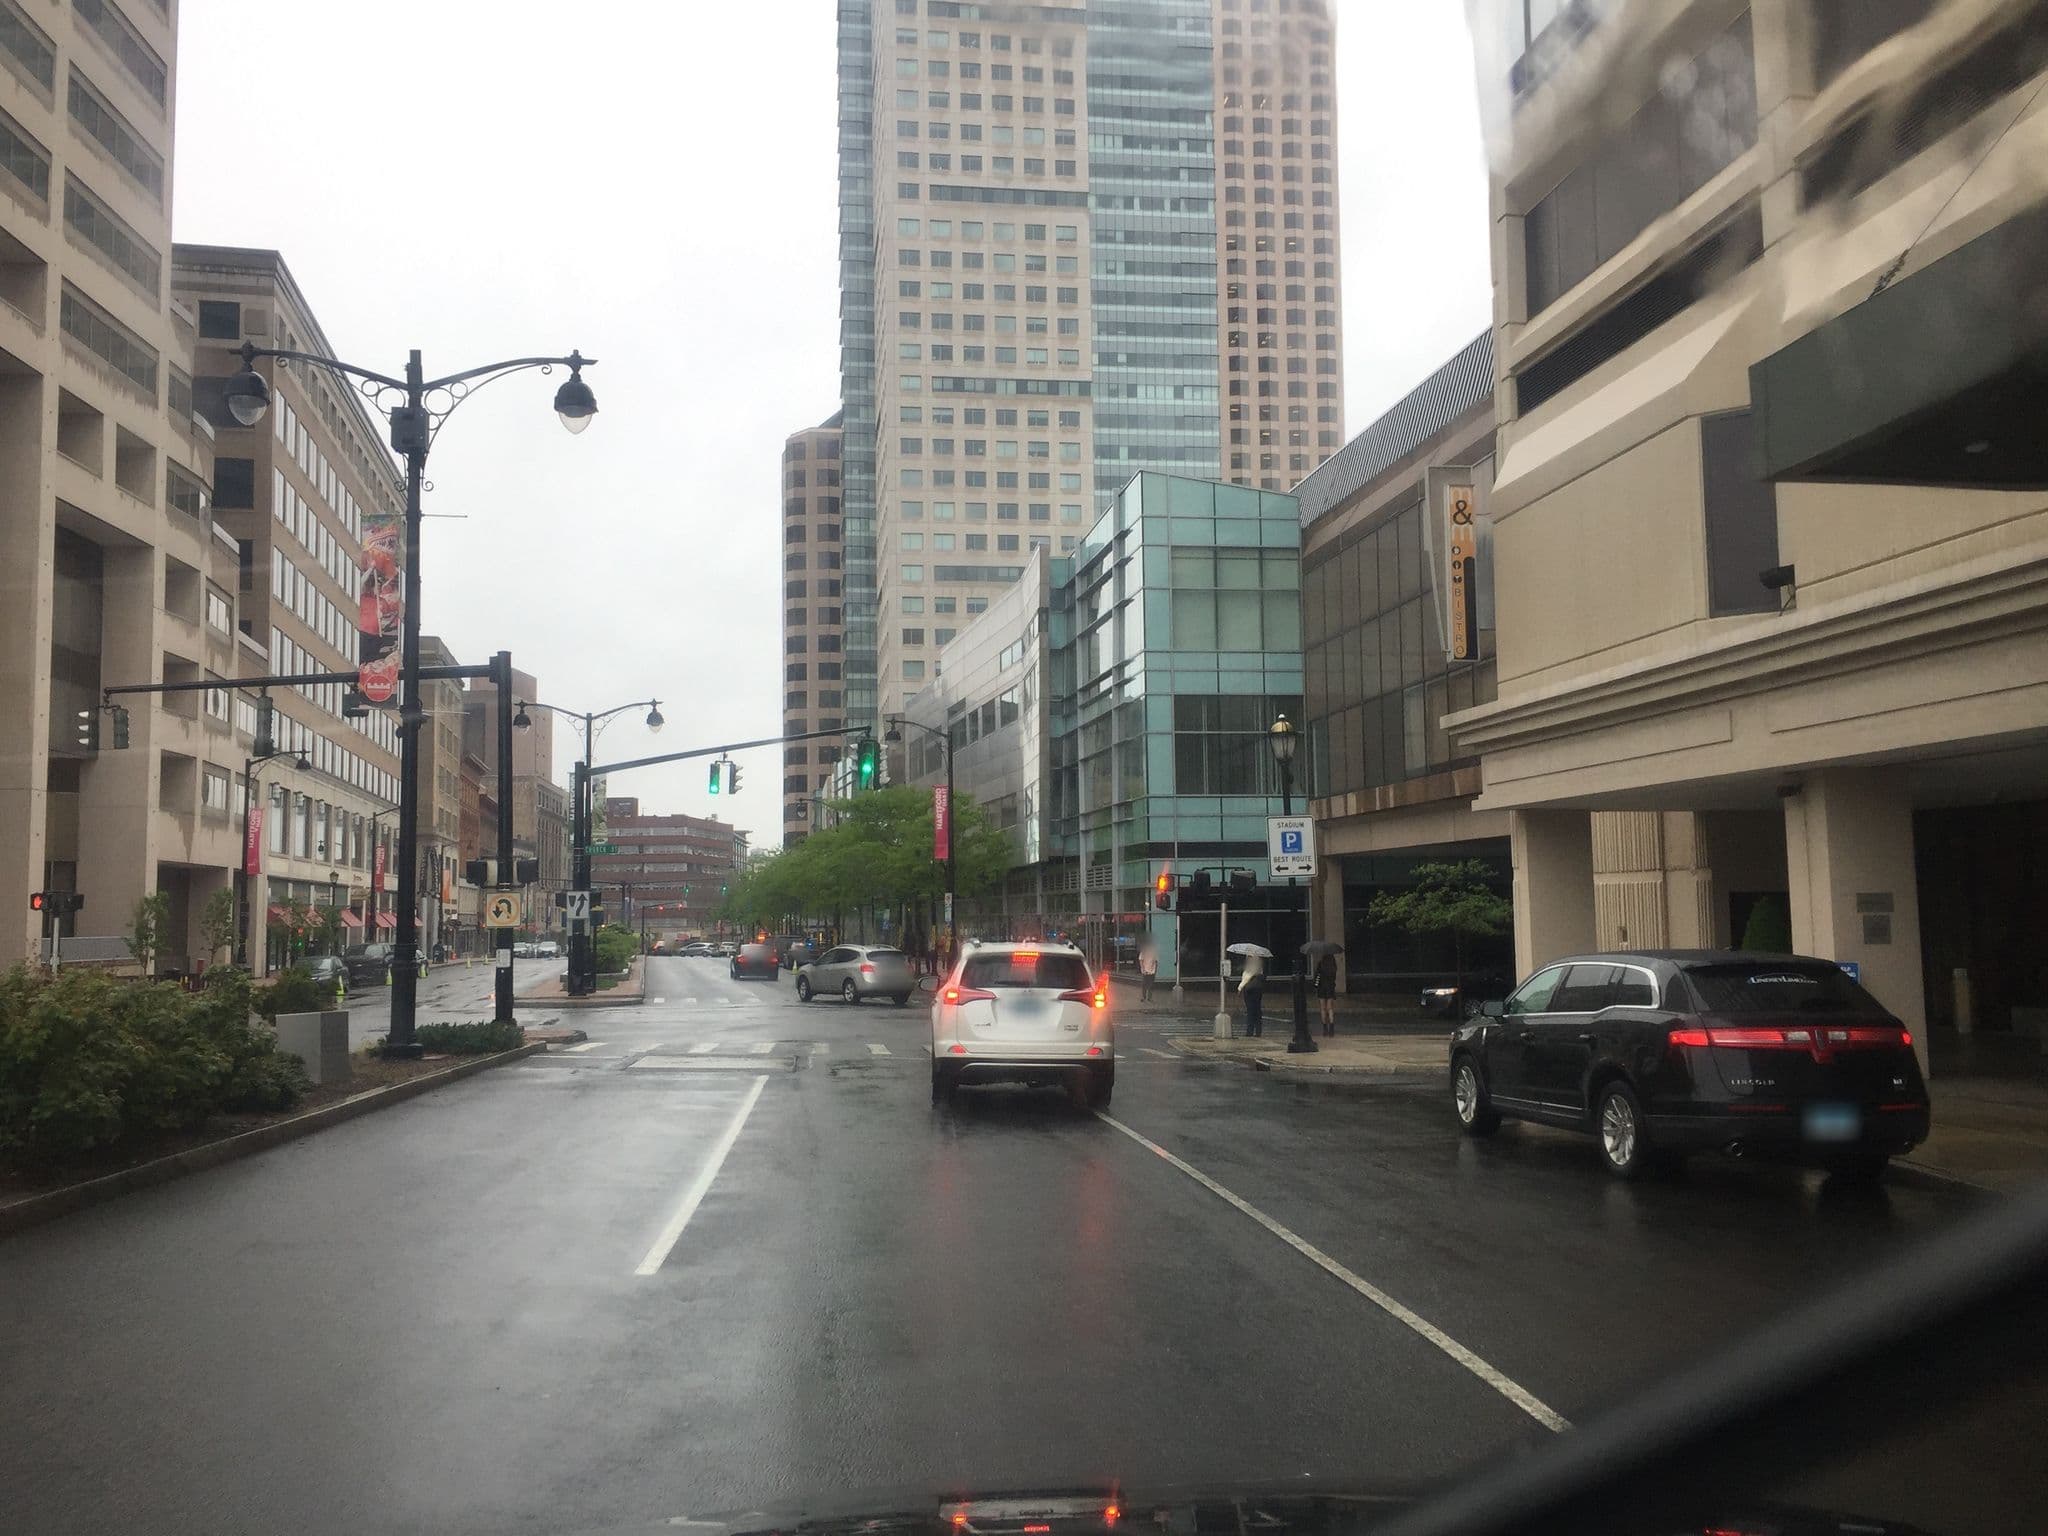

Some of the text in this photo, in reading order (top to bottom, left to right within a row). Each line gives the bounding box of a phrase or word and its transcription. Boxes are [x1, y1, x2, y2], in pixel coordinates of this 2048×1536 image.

[1455, 588, 1465, 655] BISTRO
[936, 787, 945, 830] HARTFORD
[1286, 833, 1296, 847] P
